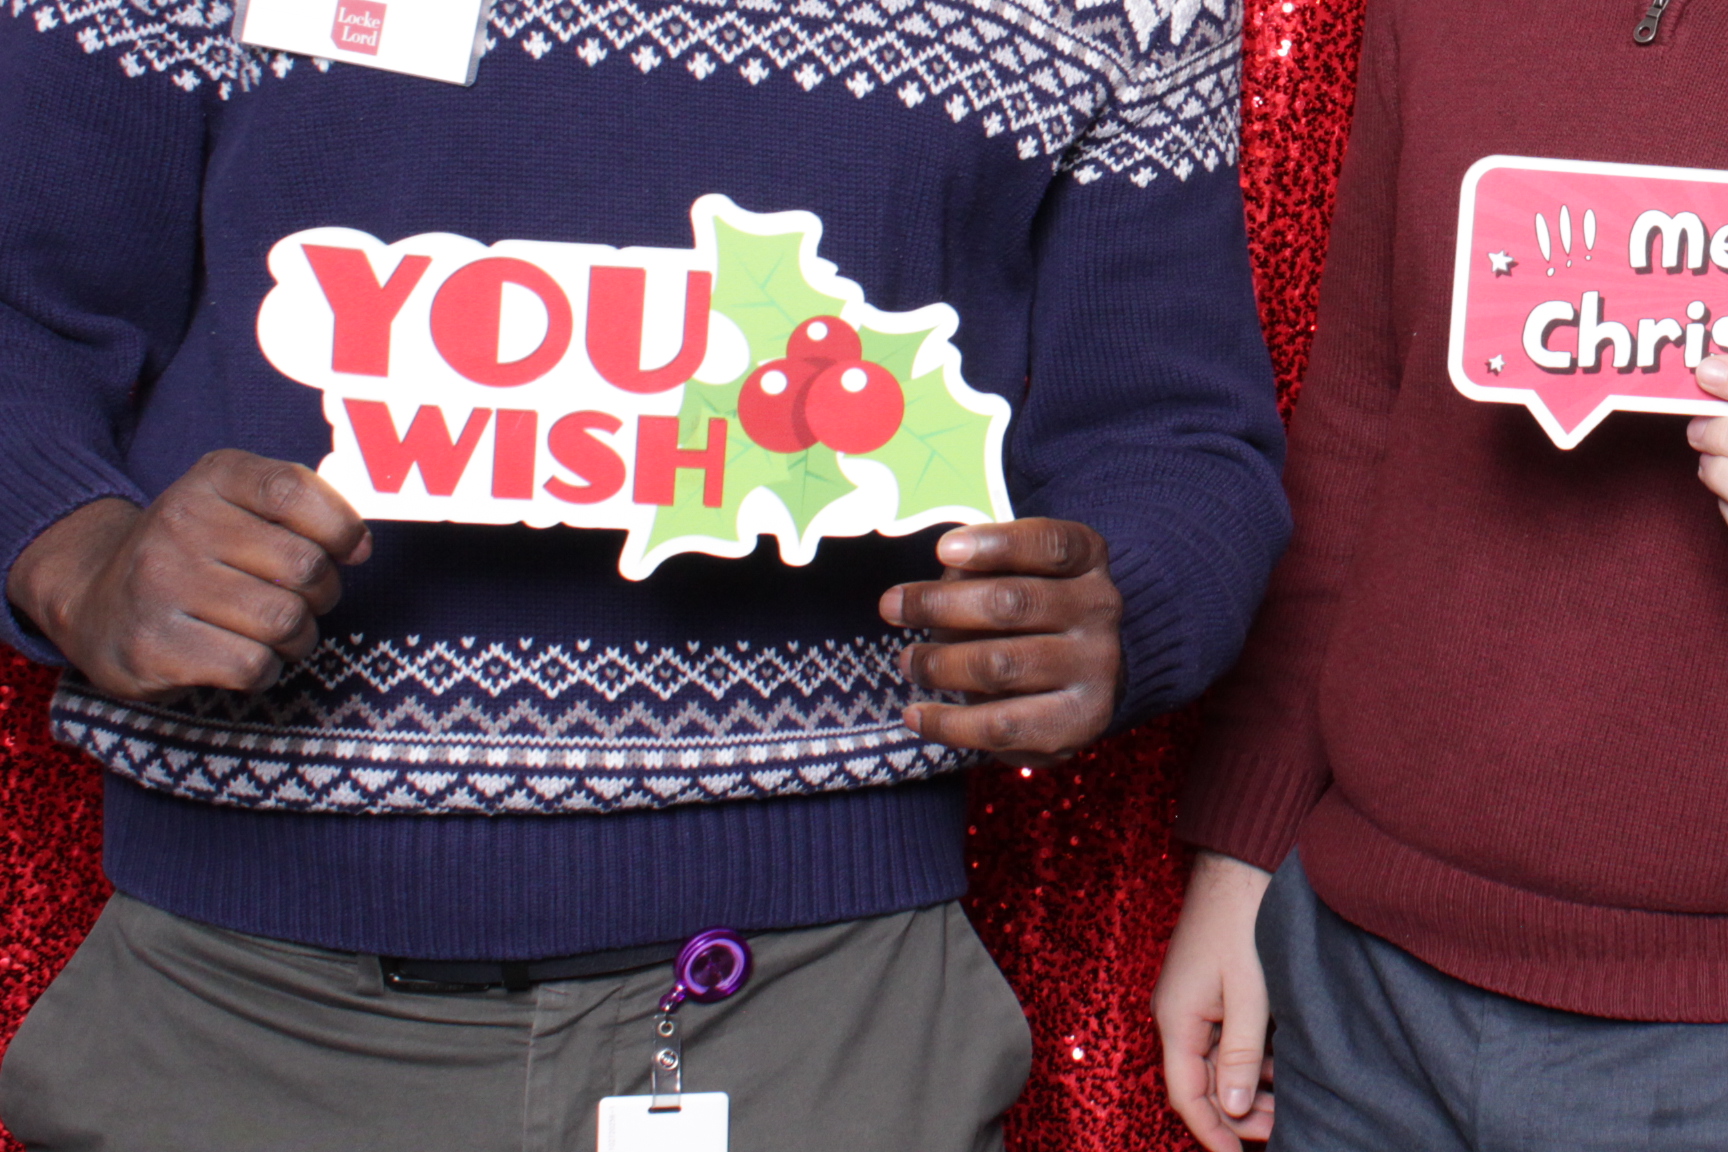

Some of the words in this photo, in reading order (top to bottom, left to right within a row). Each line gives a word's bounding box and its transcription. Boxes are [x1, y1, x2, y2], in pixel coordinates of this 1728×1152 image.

[337, 6, 381, 29] Locke
[340, 25, 378, 47] Lord
[300, 243, 713, 395] YOU
[341, 397, 728, 509] WISH
